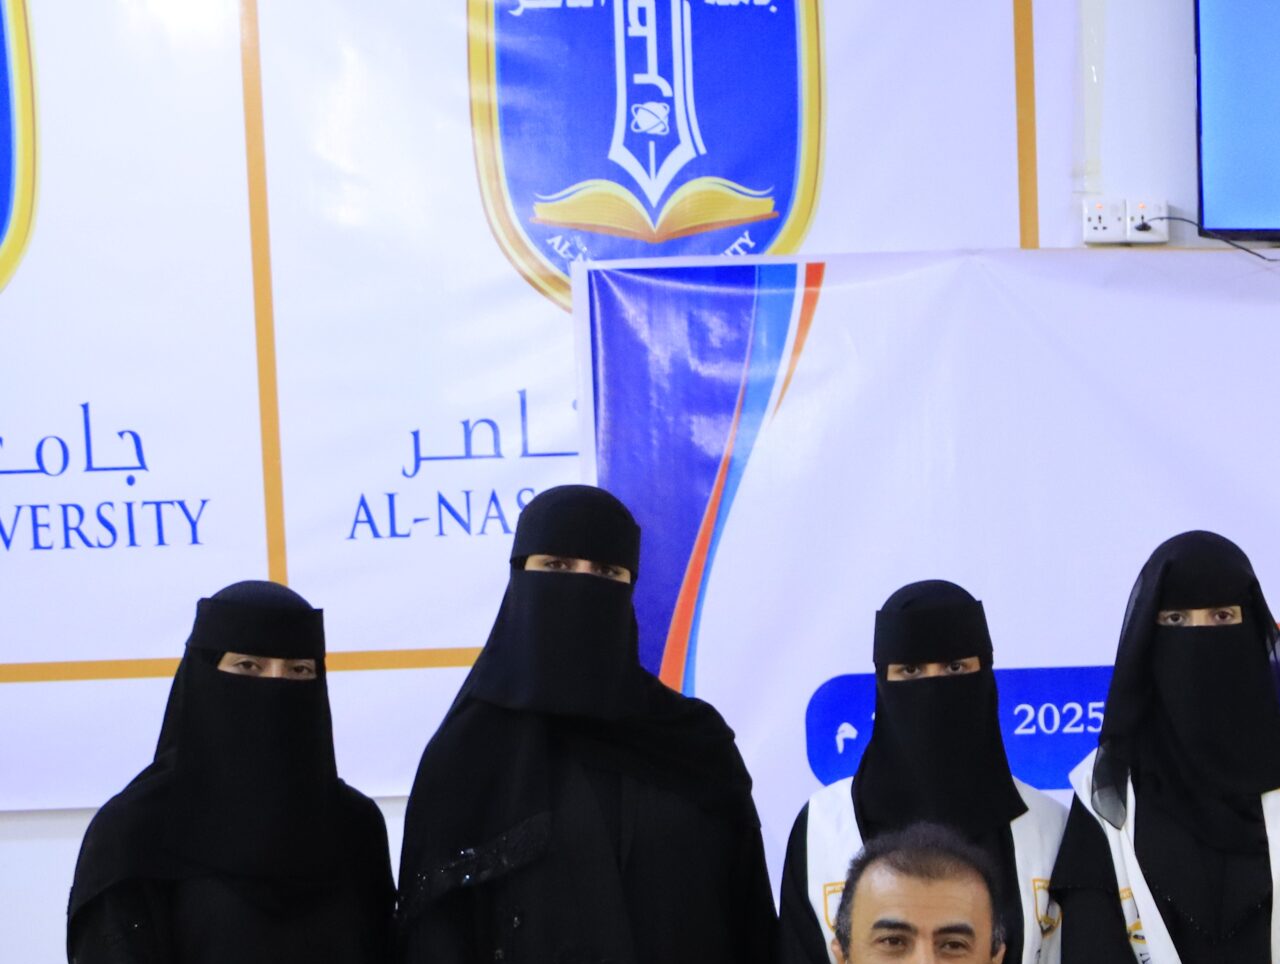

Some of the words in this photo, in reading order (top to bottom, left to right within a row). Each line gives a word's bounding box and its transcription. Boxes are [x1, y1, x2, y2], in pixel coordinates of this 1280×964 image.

[0, 401, 149, 487] جام
[0, 499, 211, 551] VERSITY
[345, 487, 535, 540] AL-NA
